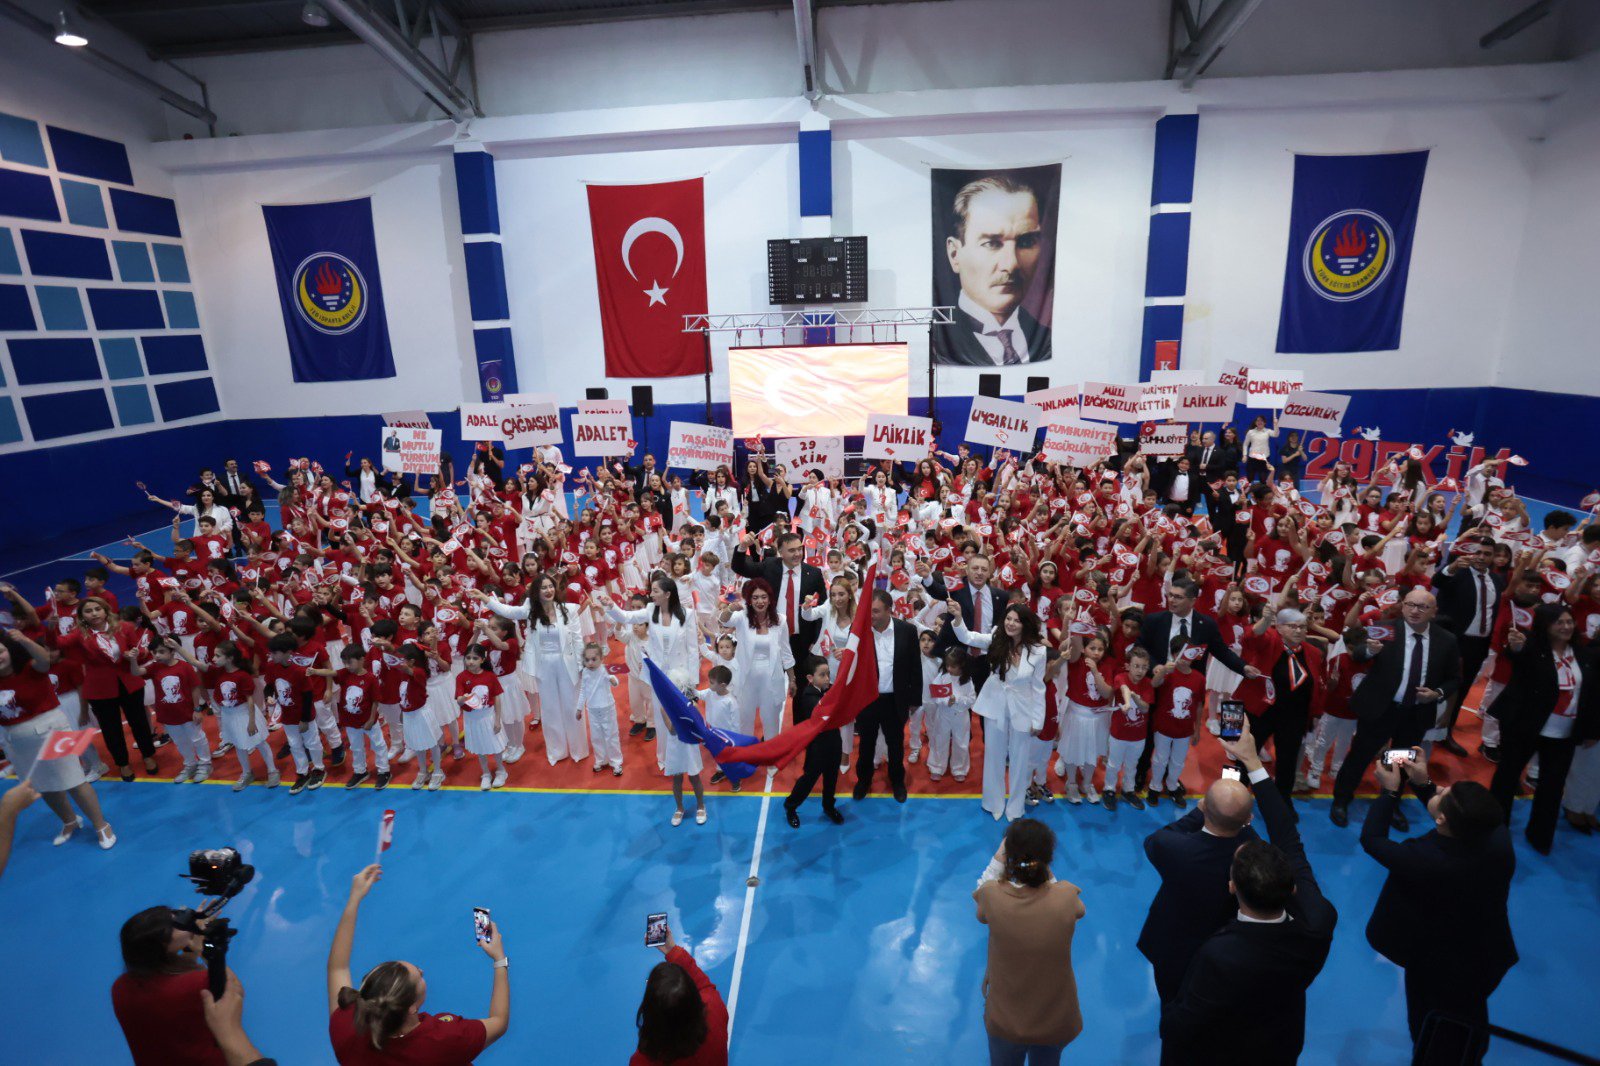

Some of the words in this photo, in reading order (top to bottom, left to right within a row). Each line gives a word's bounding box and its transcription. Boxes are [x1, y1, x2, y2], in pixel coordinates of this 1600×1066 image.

[1182, 394, 1228, 408] LAİKLİK
[1284, 402, 1340, 421] ÖZGÜRLÜK
[466, 414, 499, 427] ADALE
[971, 408, 1029, 433] UYGARLIK
[412, 430, 427, 440] NE
[575, 425, 628, 442] ADALET
[873, 423, 926, 446] LAİKLİK
[401, 441, 435, 451] MUTLU
[799, 440, 816, 451] 29
[790, 450, 828, 469] EKİM
[1303, 437, 1375, 481] 29
